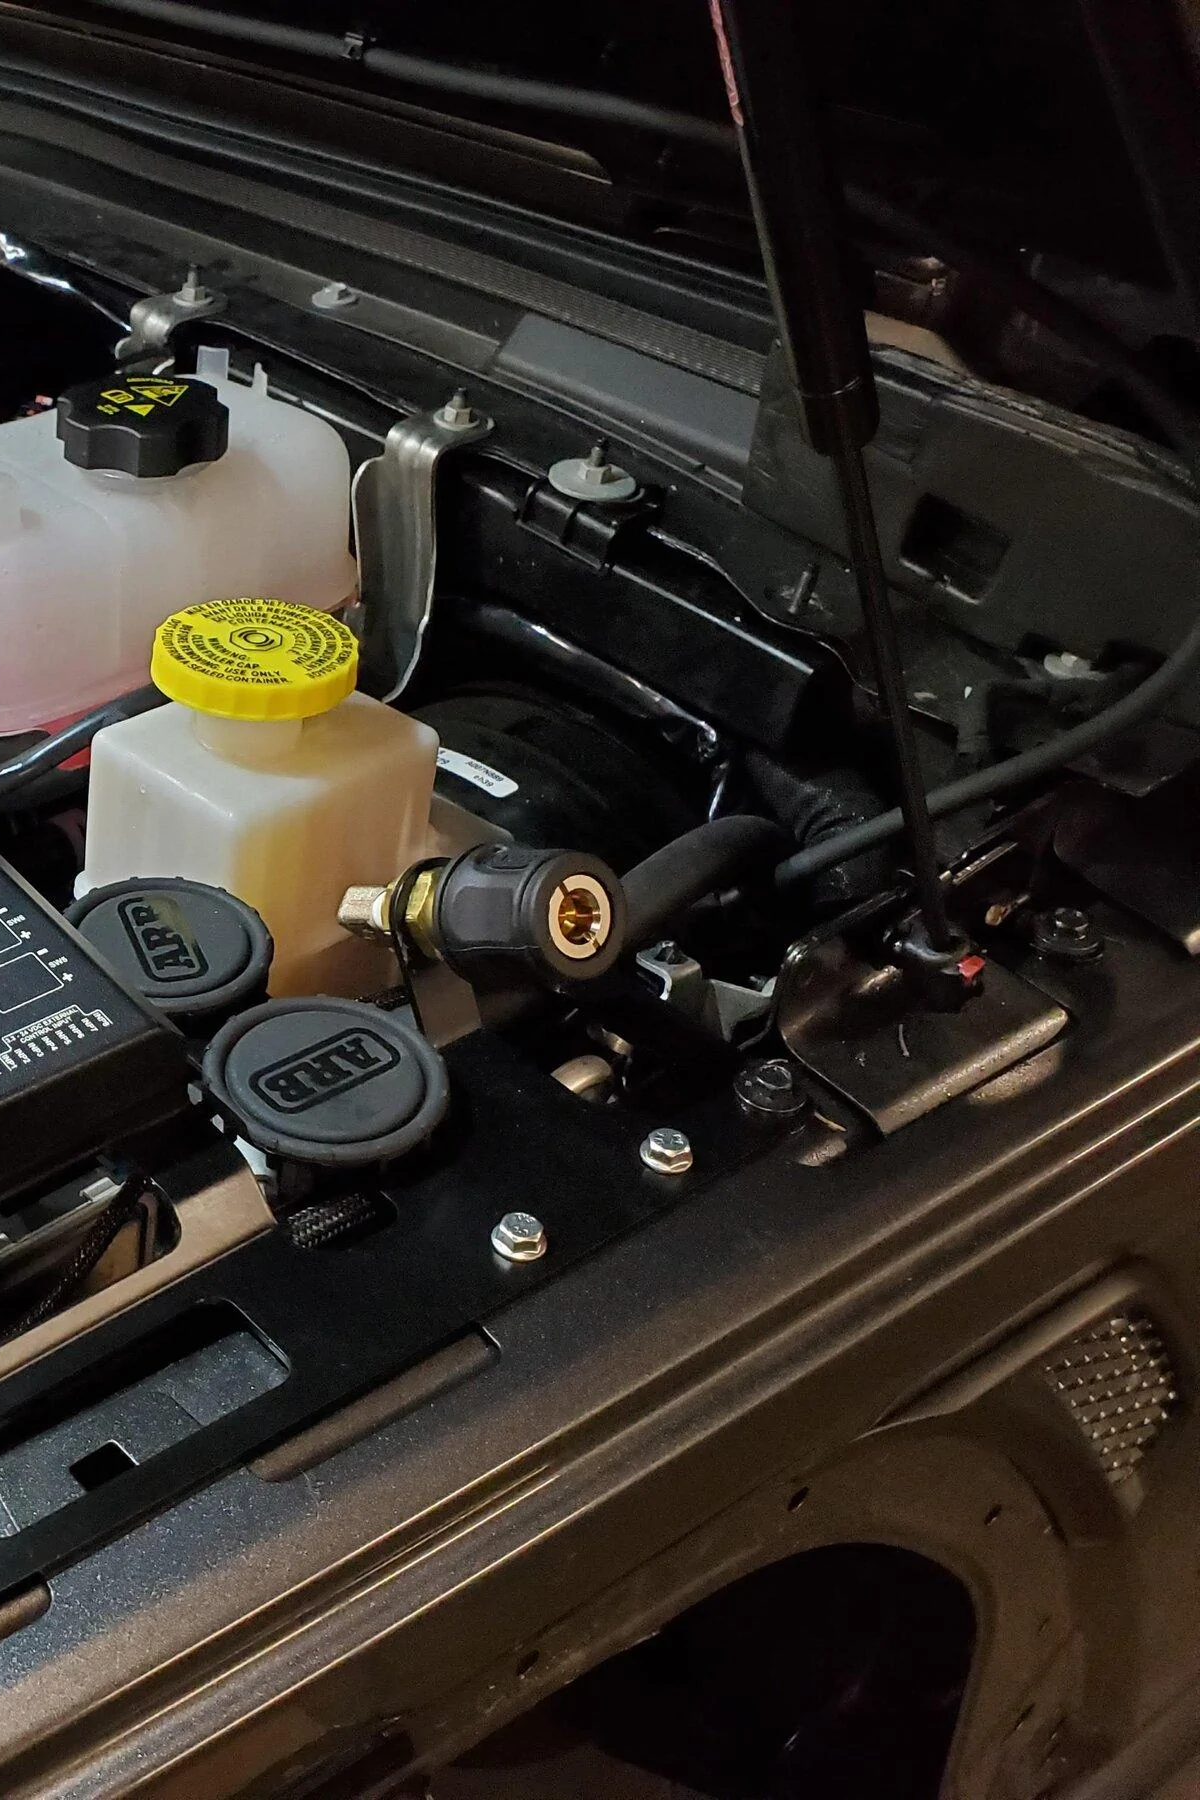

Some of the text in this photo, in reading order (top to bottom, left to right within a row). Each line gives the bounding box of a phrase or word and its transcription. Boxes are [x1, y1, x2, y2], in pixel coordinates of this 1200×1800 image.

[224, 667, 246, 675] USE
[20, 1017, 73, 1043] CONTROL INPUT
[68, 1023, 85, 1039] INP6
[81, 1018, 99, 1032] INP7
[41, 1036, 58, 1051] INP4
[55, 1030, 72, 1045] INP5
[14, 1048, 31, 1064] INP2
[27, 1042, 44, 1057] INP3
[2, 1054, 18, 1070] INP1
[264, 1034, 385, 1102] ARB
